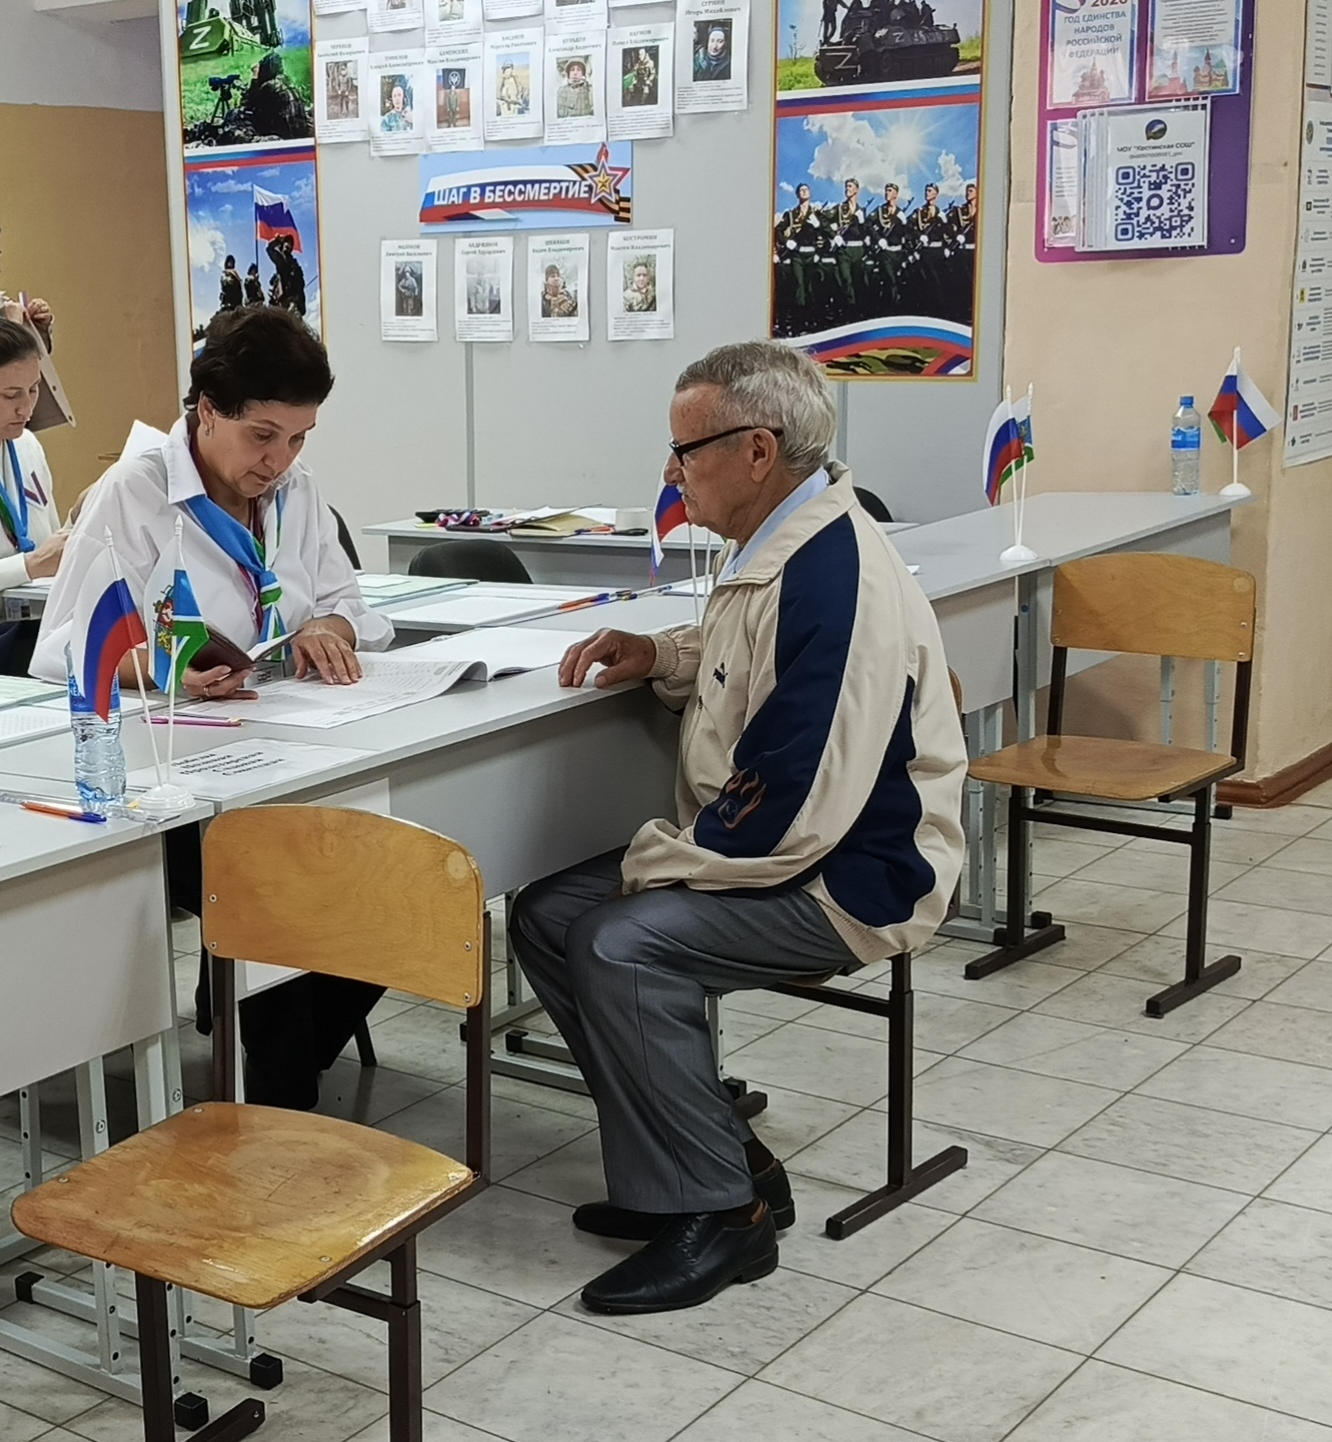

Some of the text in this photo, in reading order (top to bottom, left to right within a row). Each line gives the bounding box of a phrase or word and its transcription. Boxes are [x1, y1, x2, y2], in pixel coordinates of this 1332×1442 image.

[1064, 10, 1127, 24] ГОД ЕДИНСТВА
[1074, 24, 1115, 35] НАРОДОВ
[1066, 33, 1123, 47] РОССИЙСКОЙ
[1068, 46, 1120, 59] ФЕДЕРАЦИИ
[434, 180, 590, 205] ШАГ В БЕССМЕРТИЕ
